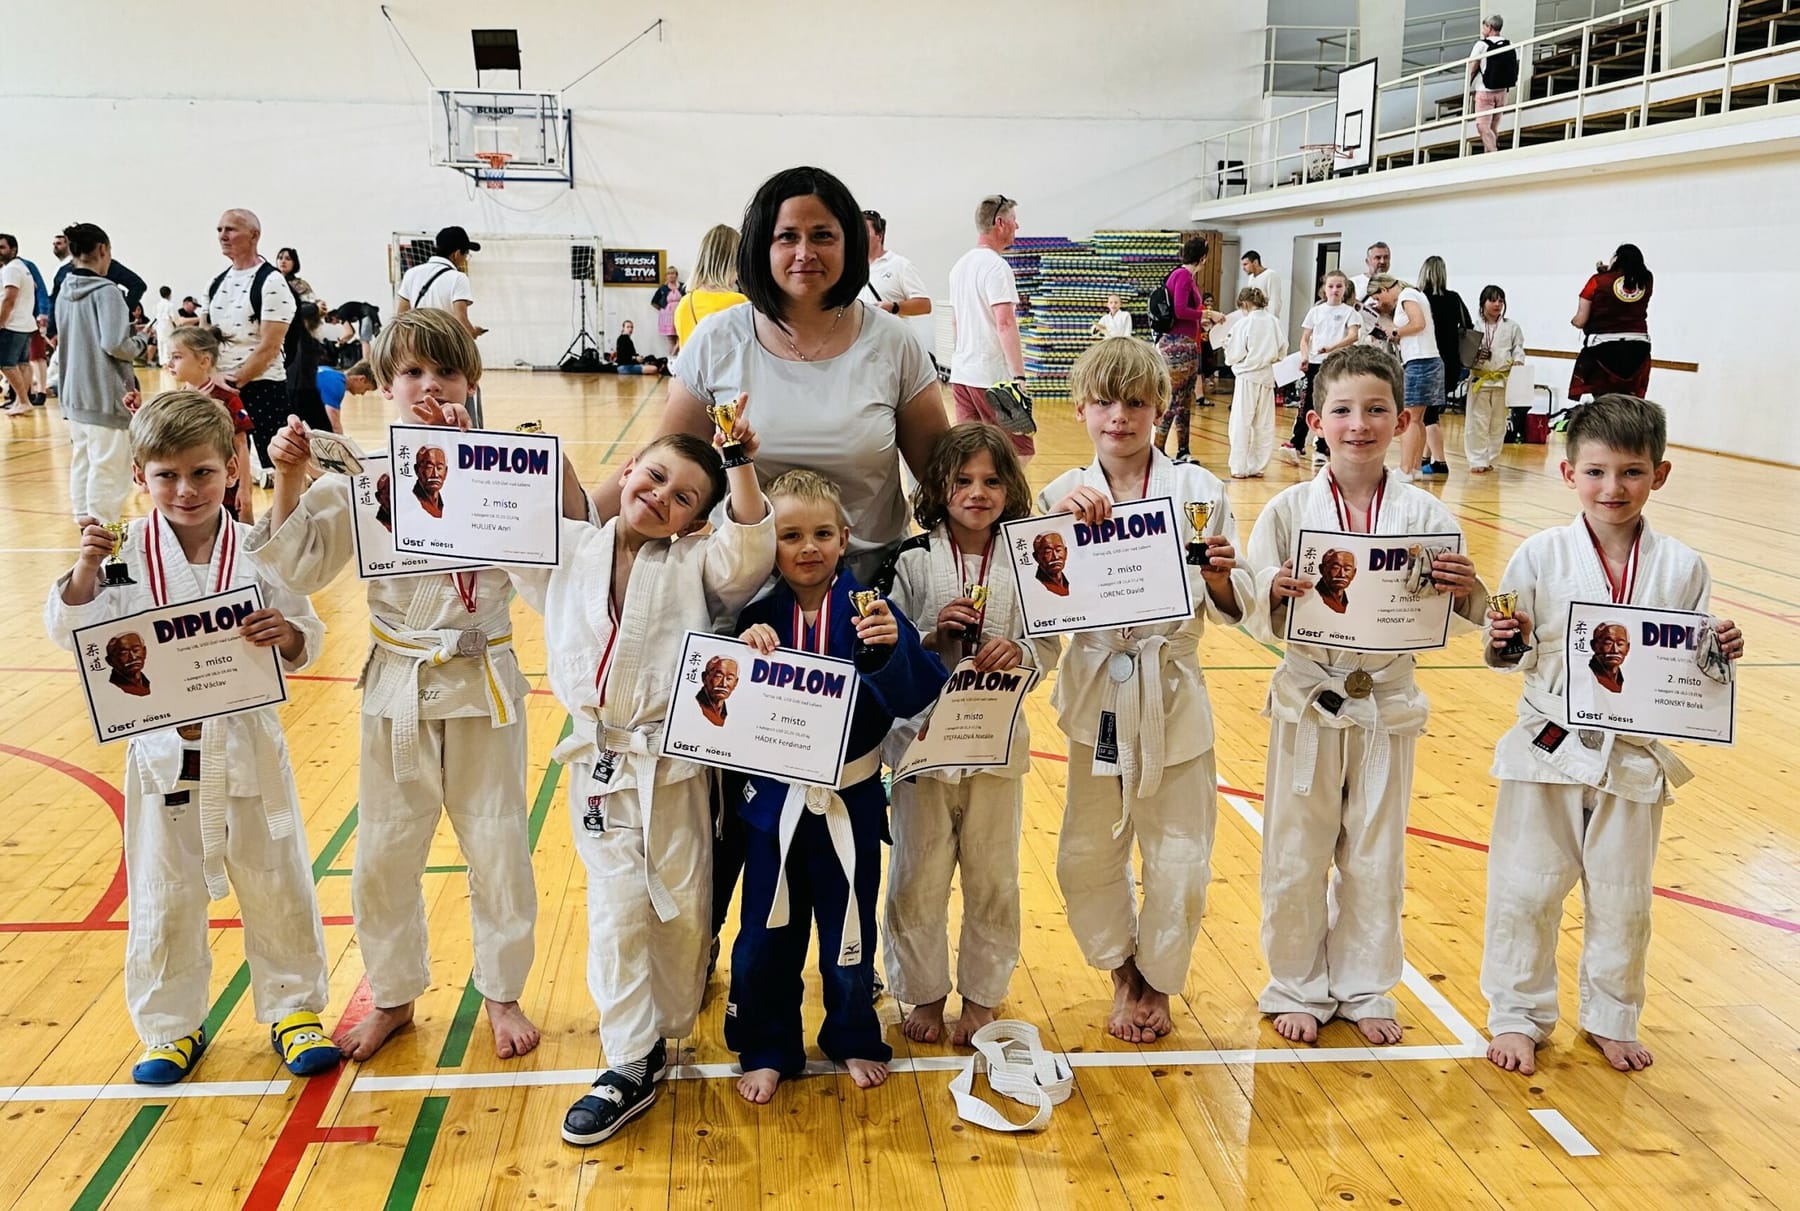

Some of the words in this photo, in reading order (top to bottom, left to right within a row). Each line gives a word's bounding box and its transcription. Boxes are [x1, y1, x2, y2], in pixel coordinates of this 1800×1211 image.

[624, 268, 656, 277] BITVA
[457, 443, 549, 476] DIPLOM
[1073, 511, 1167, 547] DIPLOM
[1369, 548, 1412, 571] DIP
[152, 599, 255, 645] DIPLOM
[1642, 621, 1698, 651] DIPL
[206, 655, 233, 668] místo
[750, 658, 847, 699] DIPLOM
[946, 669, 1022, 694] DIPLOM
[1678, 675, 1702, 687] místo
[781, 714, 807, 727] místo
